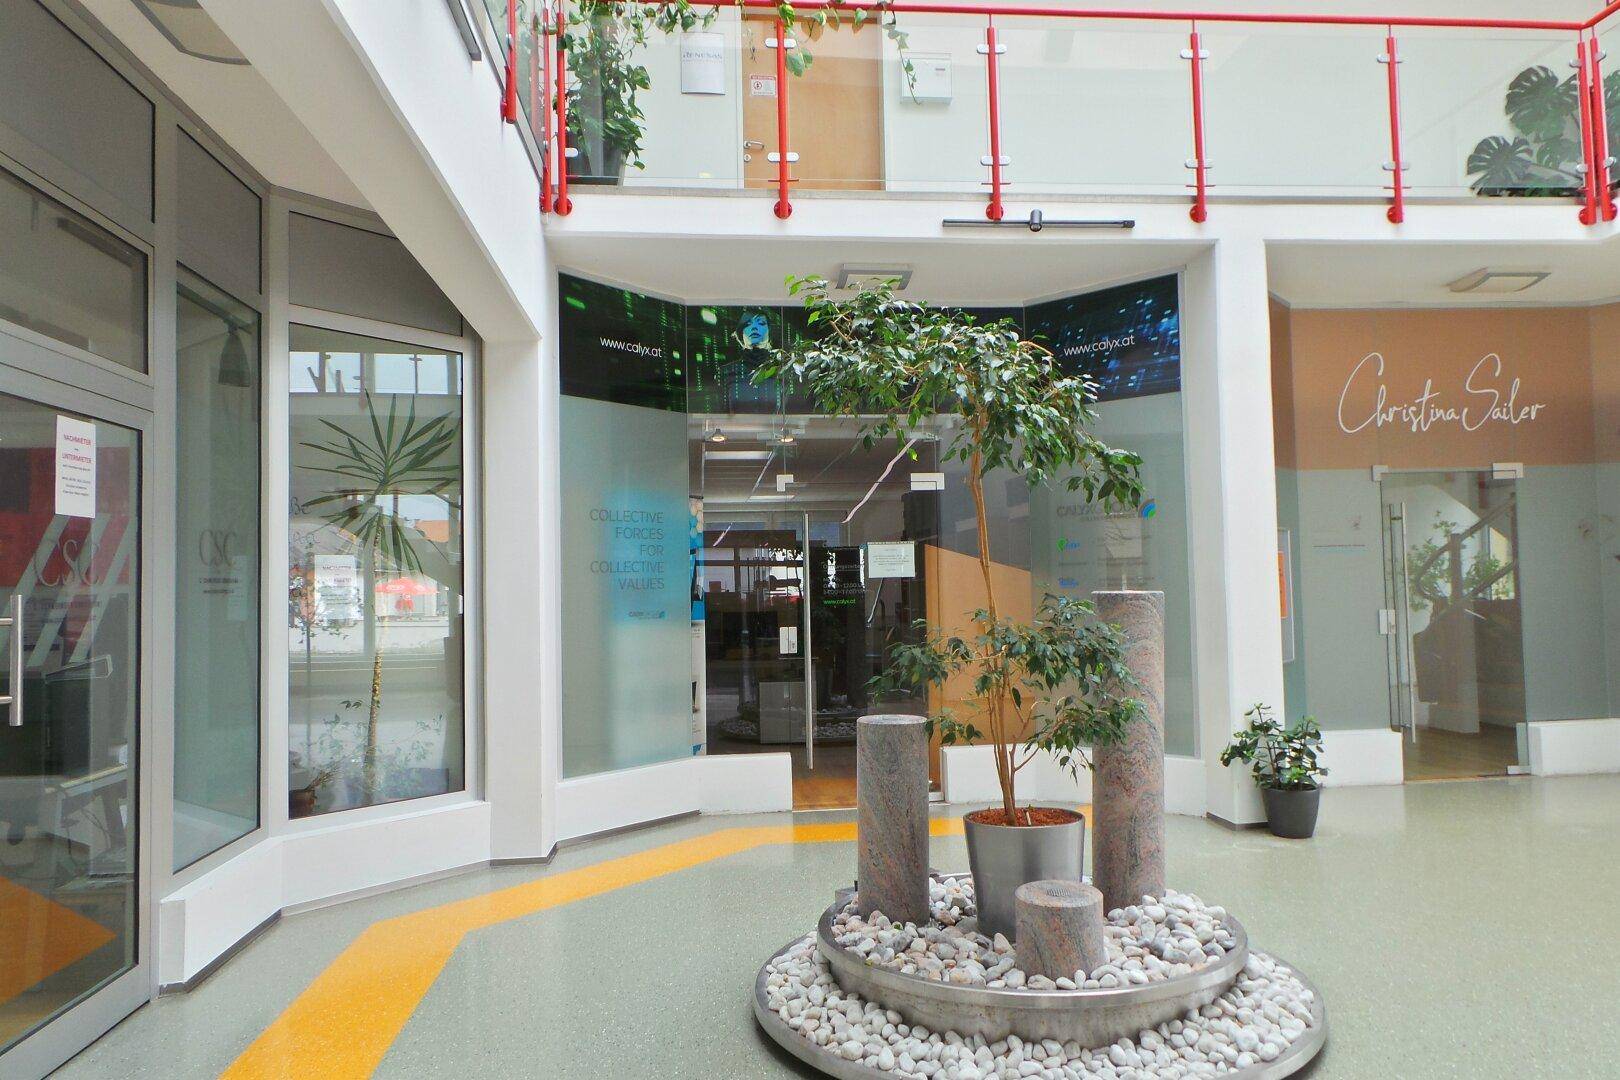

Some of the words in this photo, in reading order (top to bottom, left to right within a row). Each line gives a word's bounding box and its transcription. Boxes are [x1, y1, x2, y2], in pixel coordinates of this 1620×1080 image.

[599, 336, 663, 358] www.calyx.at
[1063, 334, 1136, 357] www.calyx.at
[1338, 352, 1460, 434] Christina
[1461, 353, 1546, 432] Sailer
[589, 508, 664, 523] COLLECTIVE
[615, 527, 665, 540] FORCES
[639, 544, 665, 557] FOR
[590, 560, 665, 573] COLLECTIVE
[618, 578, 665, 590] VALUES
